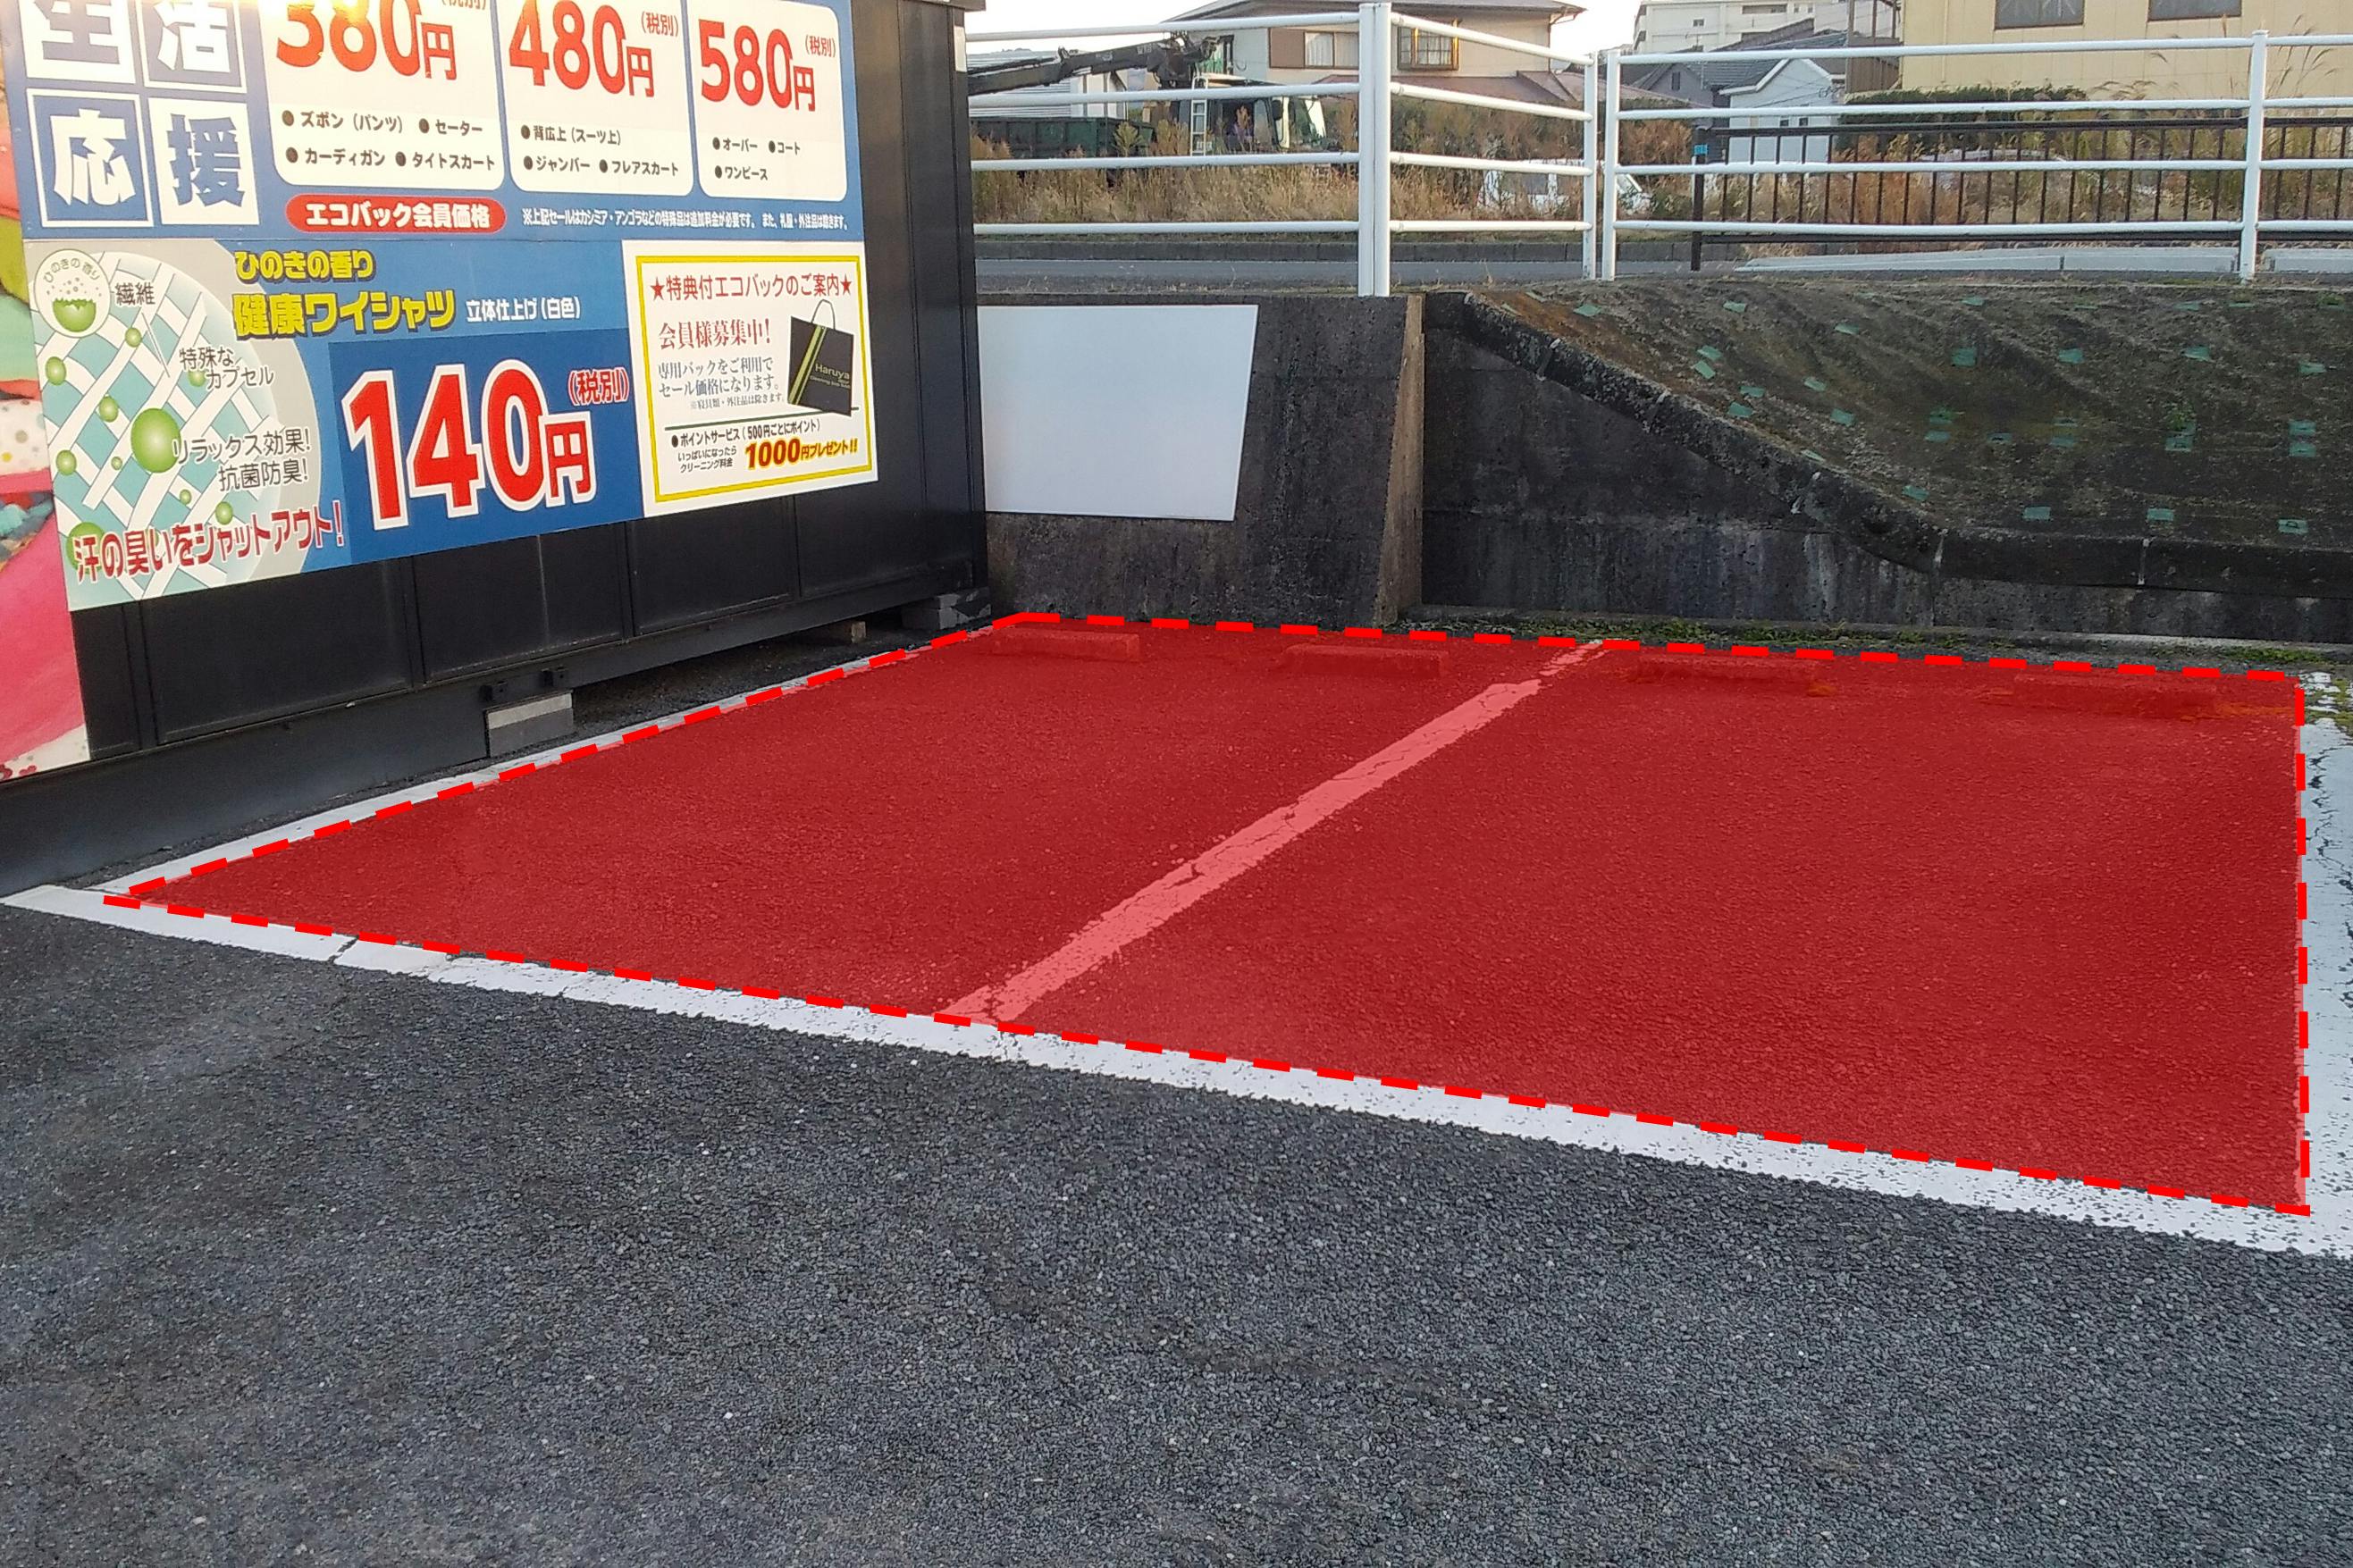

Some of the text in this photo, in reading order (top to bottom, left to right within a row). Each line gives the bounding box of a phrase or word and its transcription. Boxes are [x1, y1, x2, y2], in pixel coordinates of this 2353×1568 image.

[508, 0, 655, 97] 480円
[698, 19, 816, 112] 580円
[435, 119, 483, 136] セーター
[50, 108, 246, 207] 応援
[305, 147, 495, 171] カーディガン タイトスカート
[777, 141, 801, 155] コート
[612, 161, 679, 176] フレアスカート
[724, 165, 769, 180] ワンピース
[306, 201, 491, 230] エコバック会員価格
[234, 249, 374, 281] ひのきの香り
[114, 281, 155, 306] 繊維
[231, 289, 456, 338] 健康ワイシャツ
[179, 347, 234, 370] 特殊な
[206, 365, 274, 390] カプセル
[815, 363, 850, 380] Haruya
[343, 361, 596, 531] 140円
[677, 445, 737, 462] いっぱいになったら
[680, 457, 734, 474] クリーニング料金
